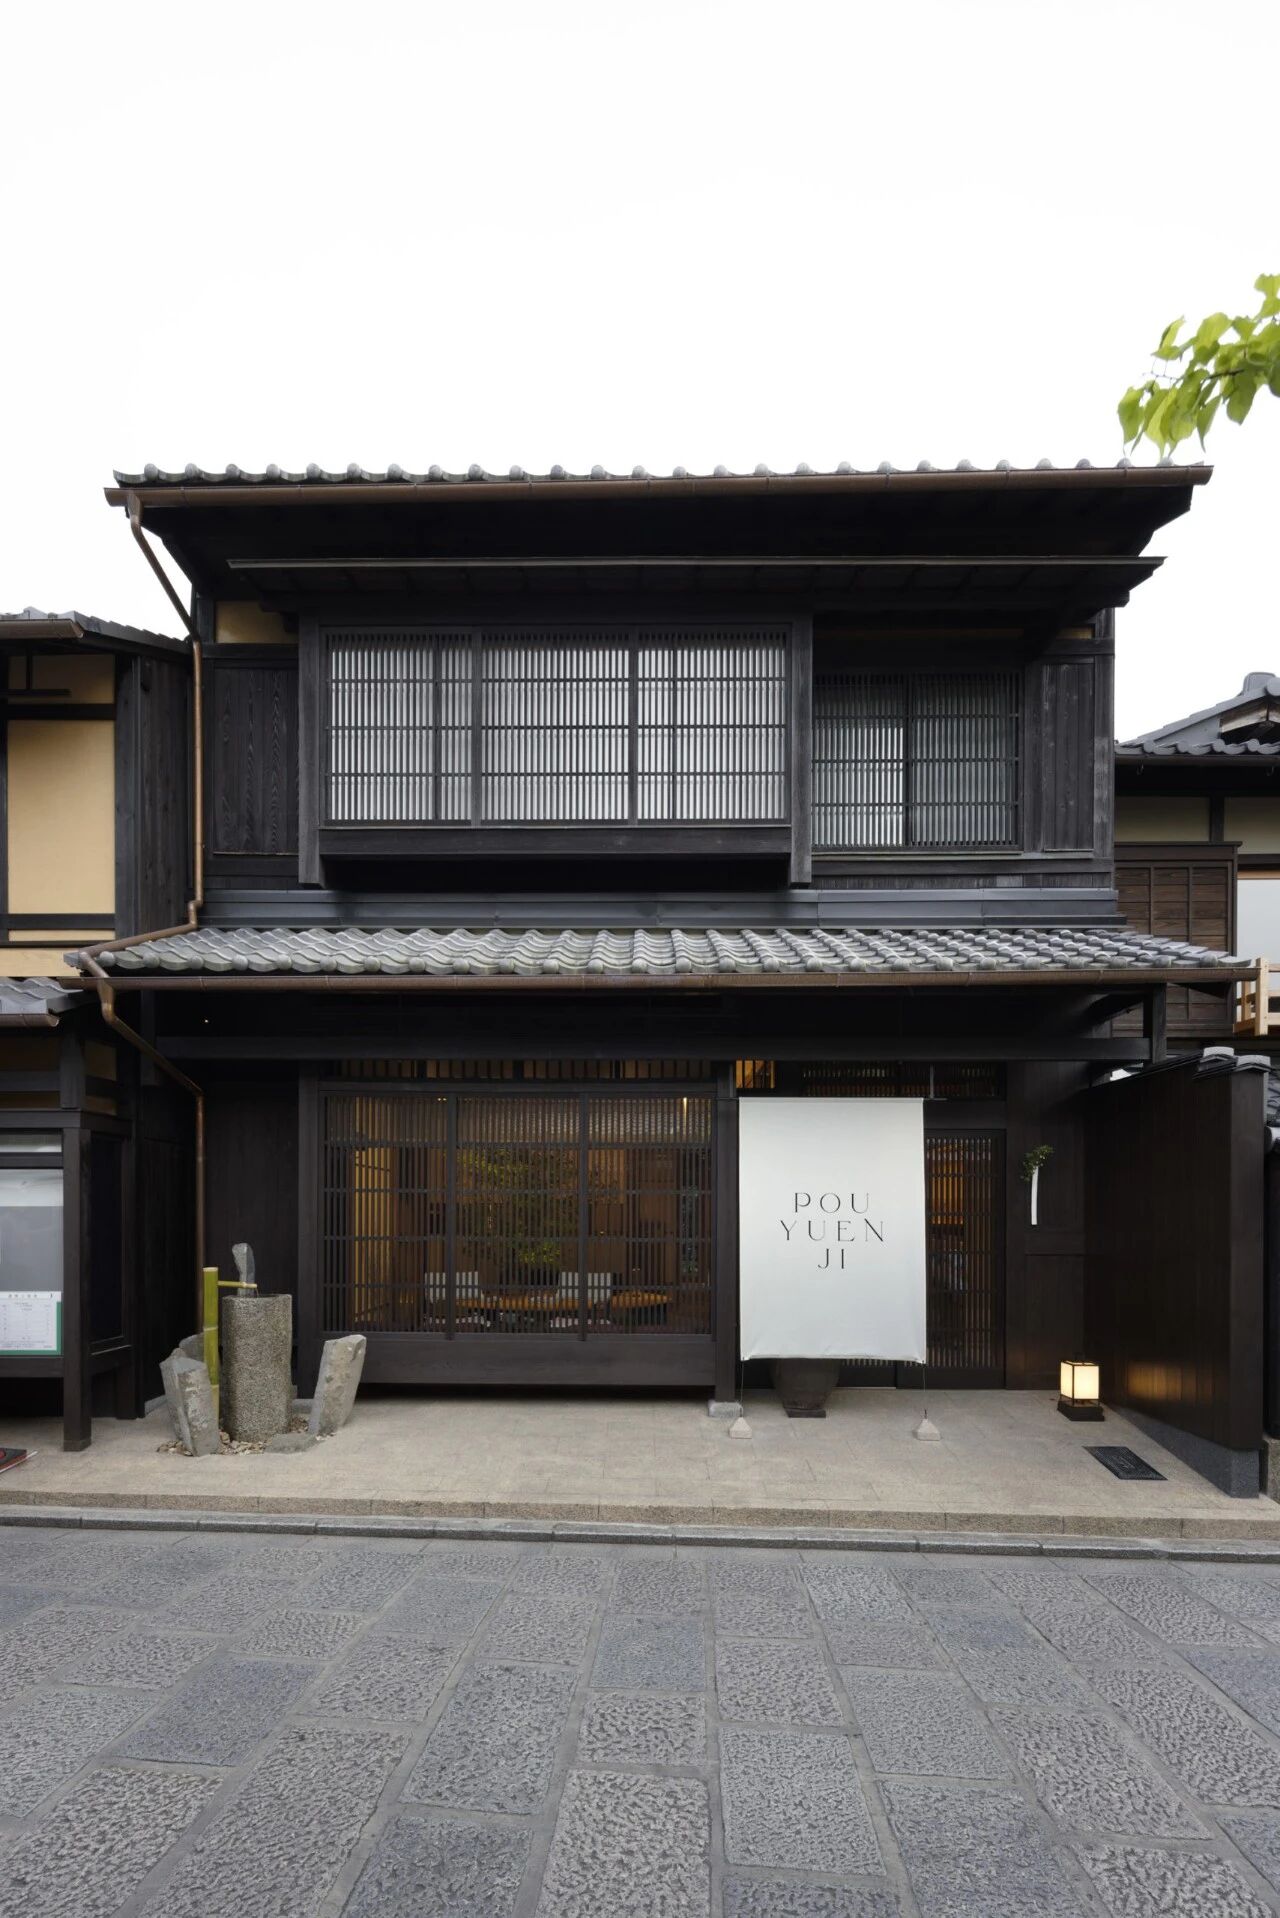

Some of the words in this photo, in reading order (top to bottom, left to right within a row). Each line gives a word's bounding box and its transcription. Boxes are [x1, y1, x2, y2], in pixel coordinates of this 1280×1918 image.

[794, 1192, 869, 1214] POU
[780, 1218, 884, 1242] YUEN
[817, 1248, 844, 1269] JI
